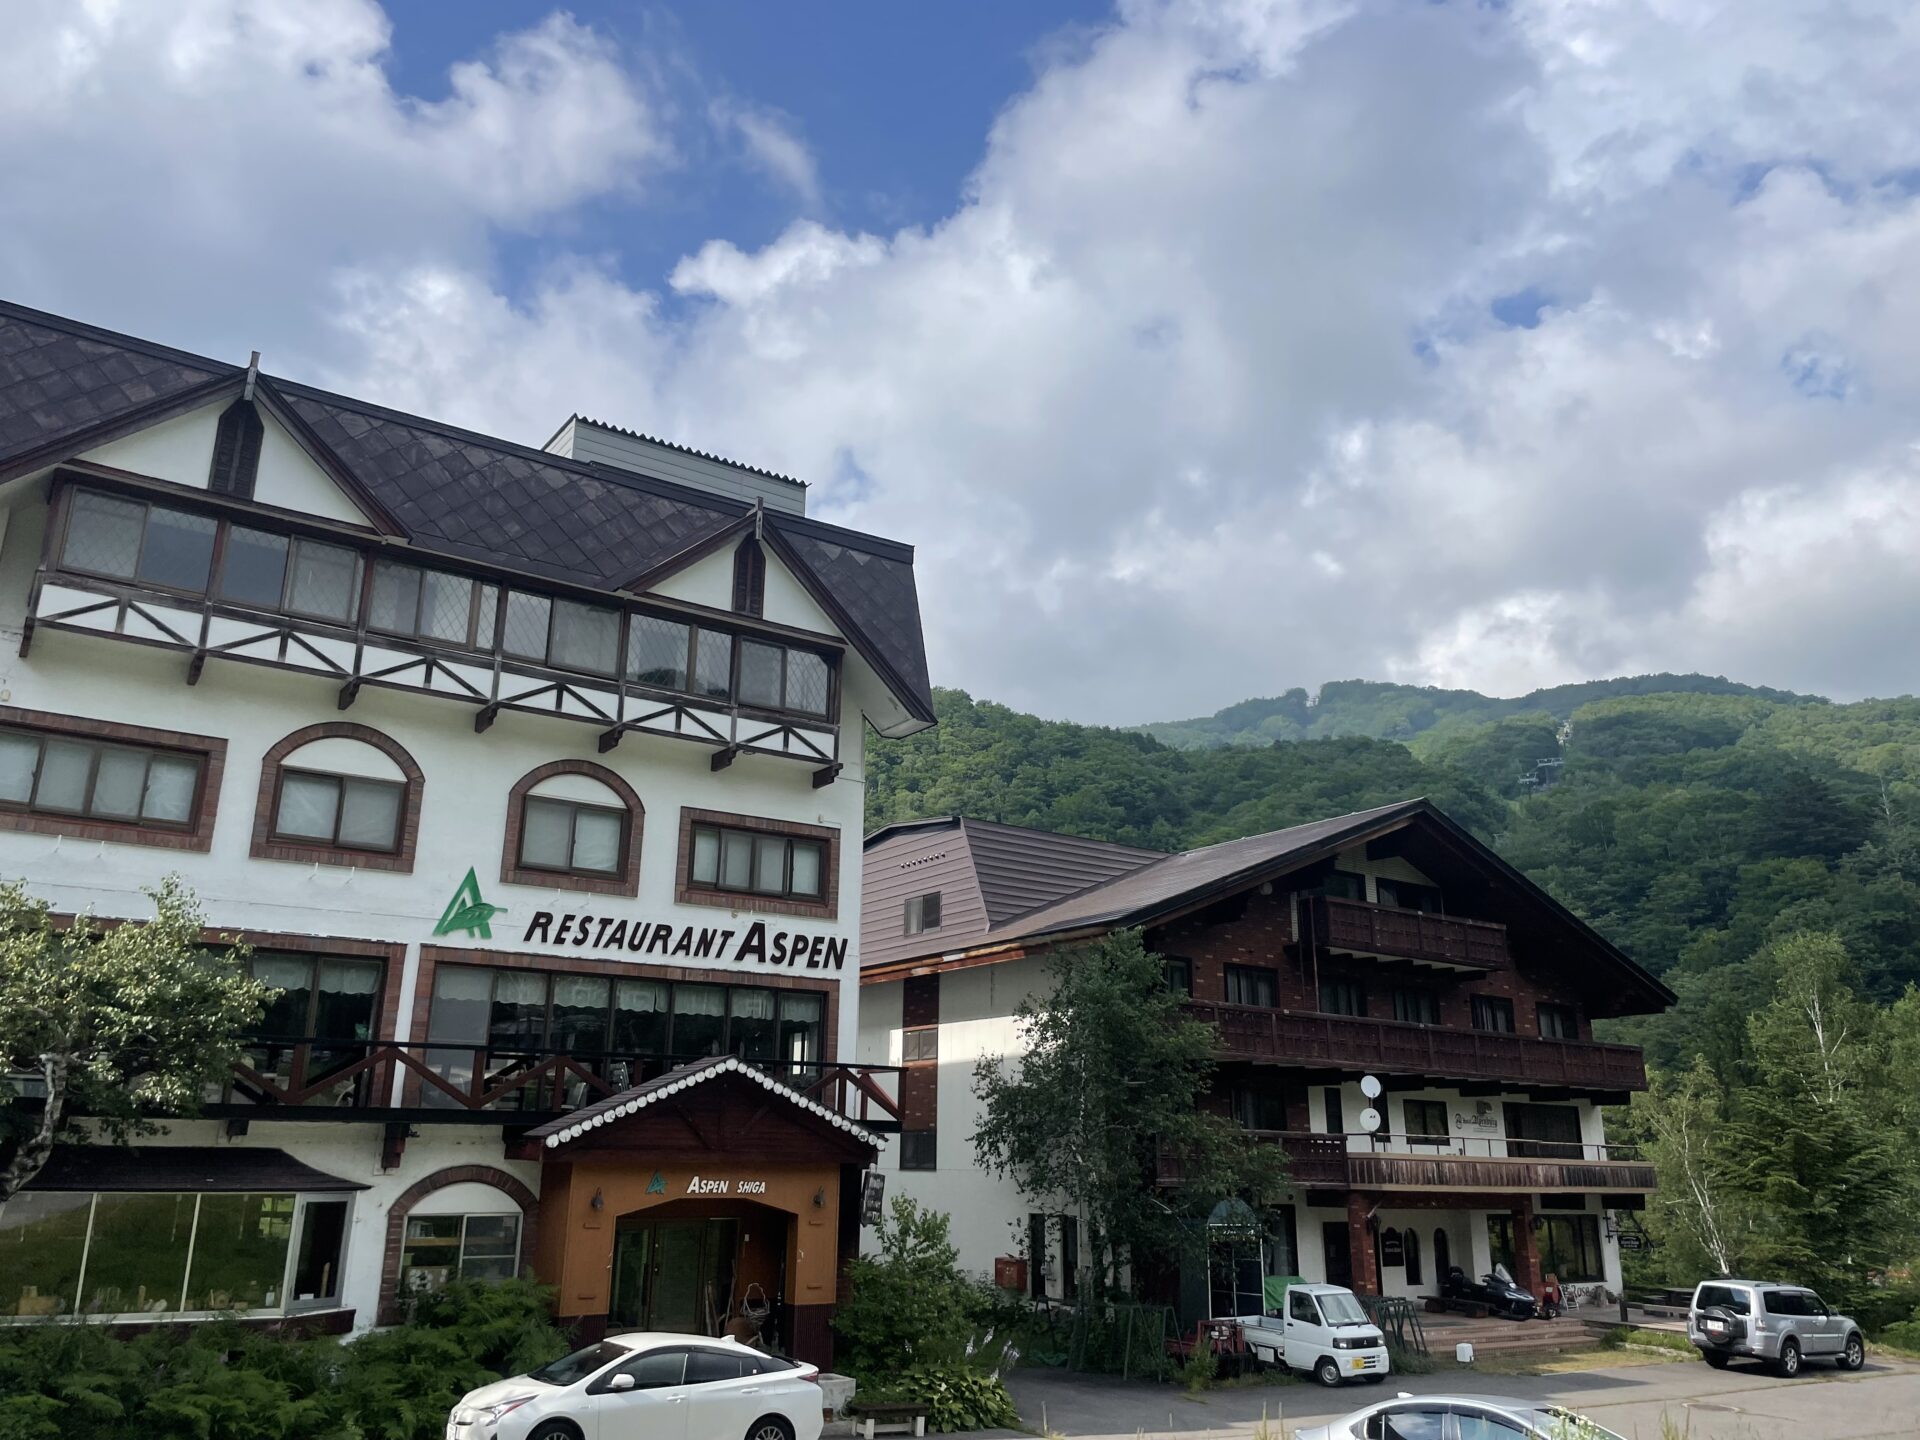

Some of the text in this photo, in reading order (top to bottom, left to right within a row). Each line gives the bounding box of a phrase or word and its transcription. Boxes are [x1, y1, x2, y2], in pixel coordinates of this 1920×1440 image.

[523, 911, 848, 970] RESTAURANT ASPEN
[686, 1176, 766, 1194] ASPEN SHIGA
